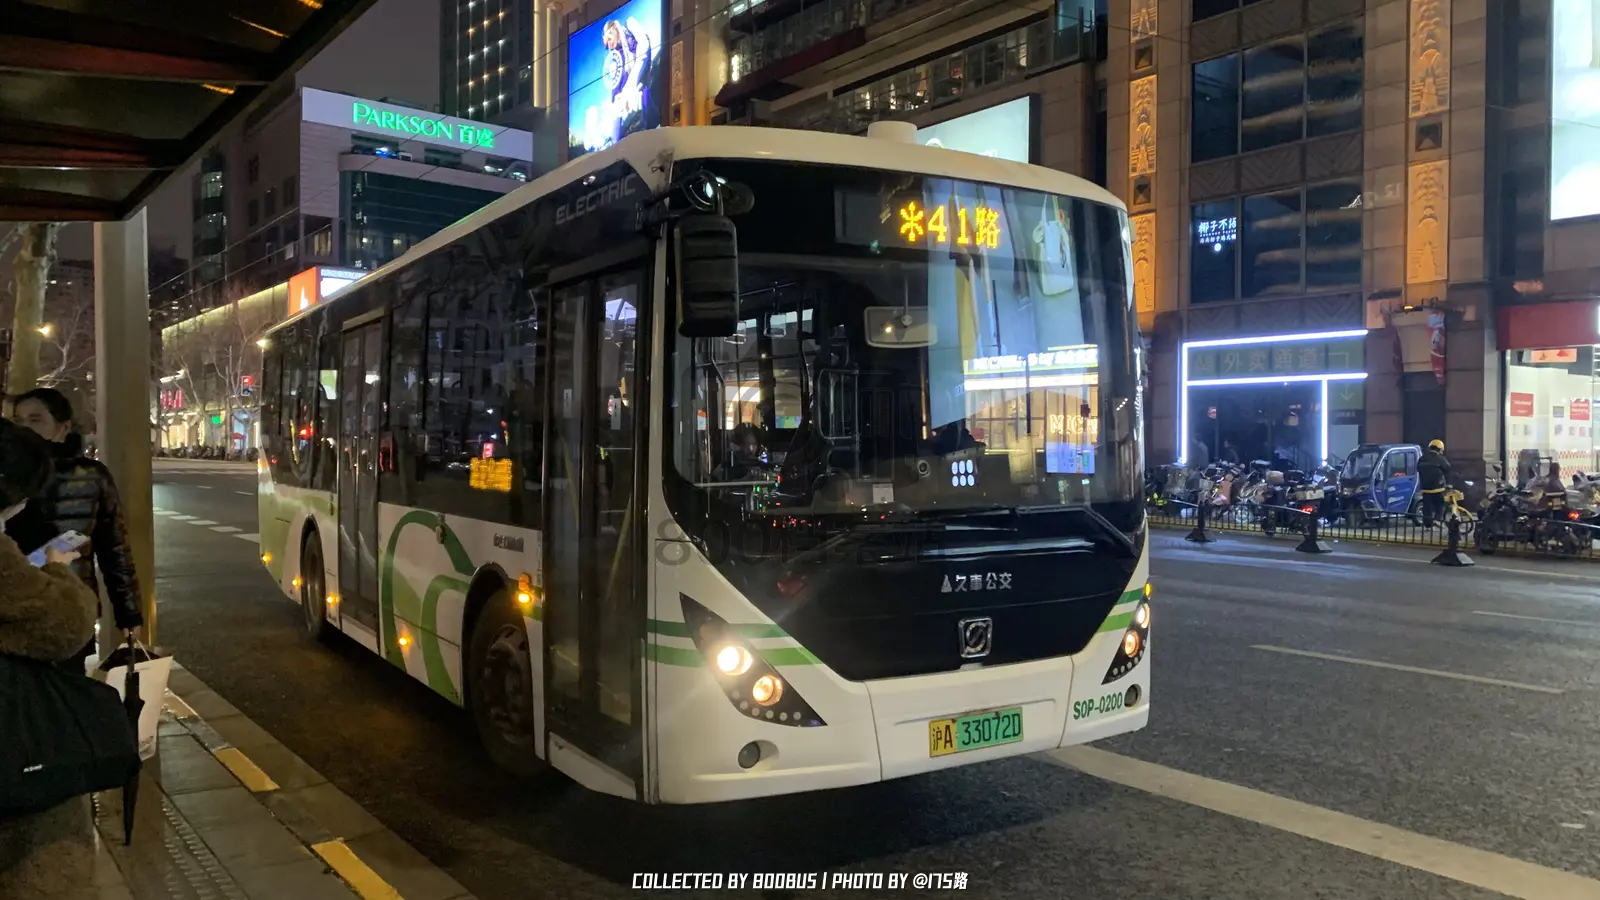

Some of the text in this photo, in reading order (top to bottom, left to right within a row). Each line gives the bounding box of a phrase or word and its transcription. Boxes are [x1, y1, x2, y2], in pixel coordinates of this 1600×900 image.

[353, 102, 494, 148] PARKSON 百盛
[556, 173, 636, 225] ELECTRIC
[928, 205, 1000, 248] 41路
[1224, 347, 1320, 373] 外卖通道
[955, 571, 1012, 592] 久事公交
[1073, 692, 1123, 720] SOP-0200
